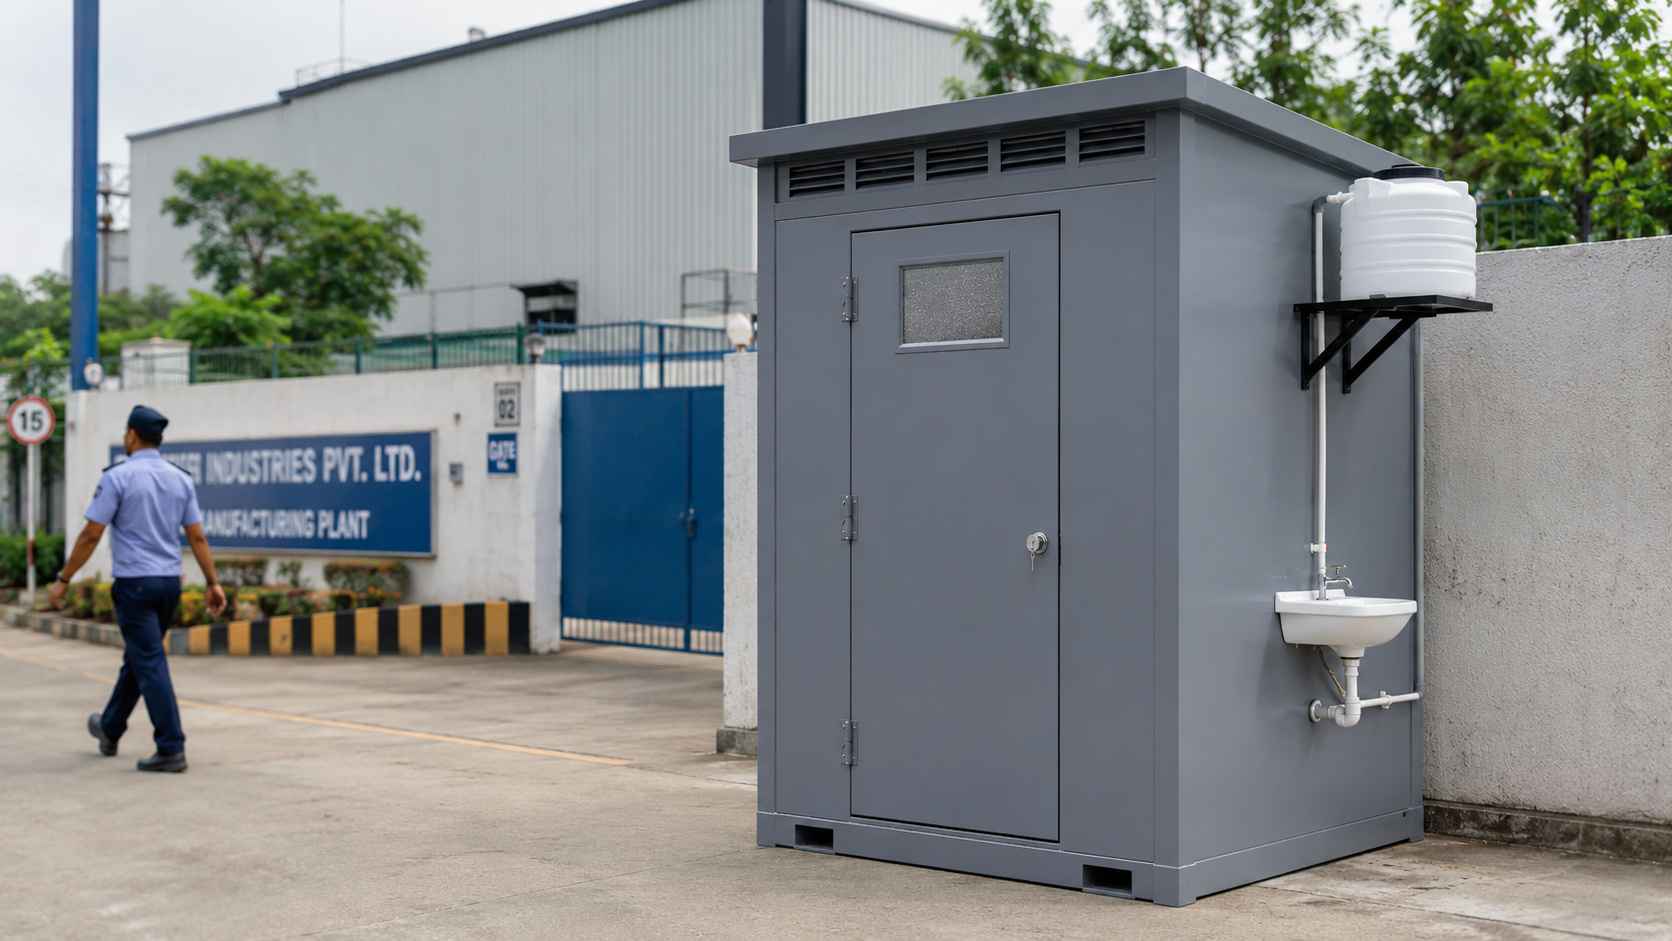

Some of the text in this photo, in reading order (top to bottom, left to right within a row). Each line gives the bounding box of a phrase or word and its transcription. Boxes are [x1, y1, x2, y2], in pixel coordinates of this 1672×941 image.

[20, 410, 44, 431] 15
[498, 398, 516, 419] 02
[205, 447, 317, 485] INDUSTRIES
[322, 446, 368, 482] PVT.
[374, 444, 421, 481] LTD.
[318, 510, 371, 540] PLANT
